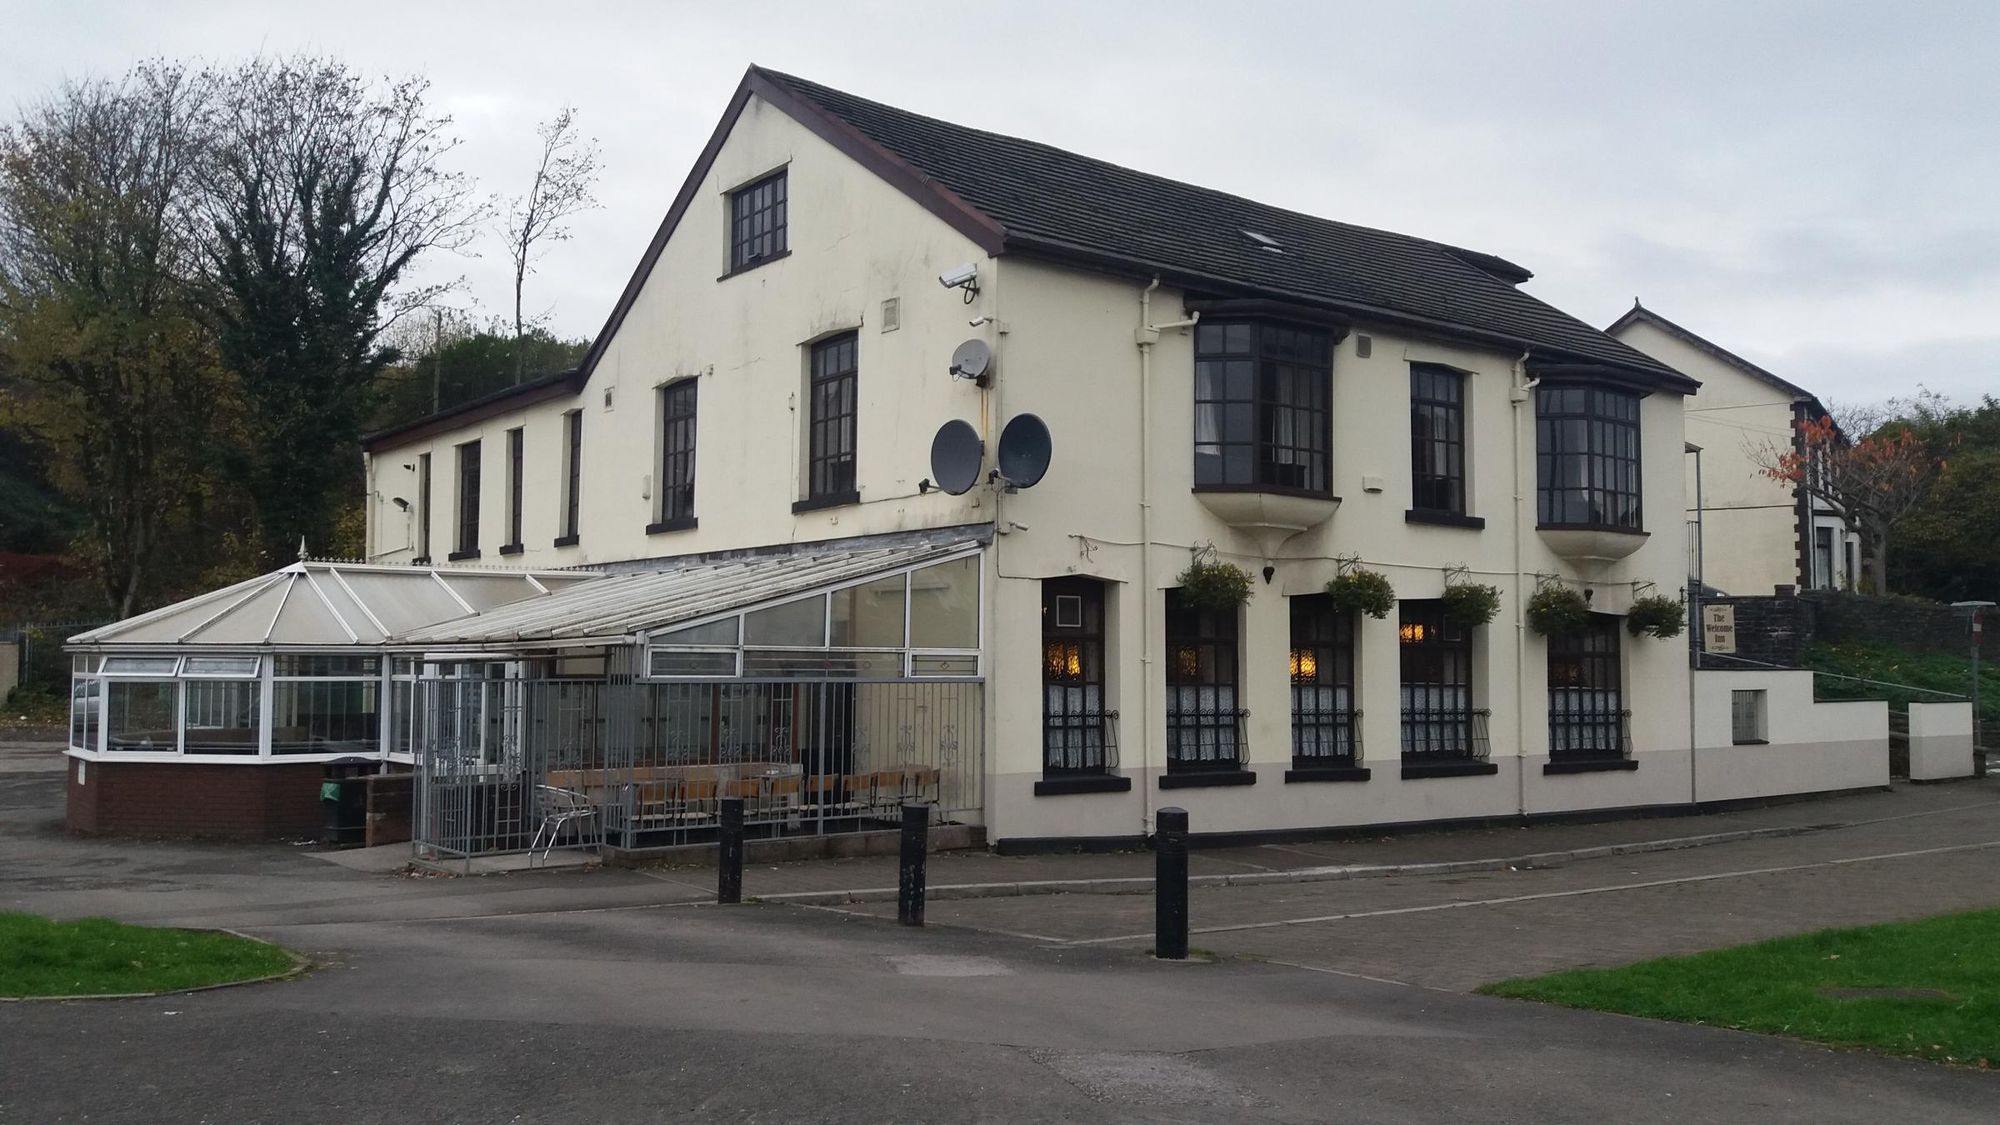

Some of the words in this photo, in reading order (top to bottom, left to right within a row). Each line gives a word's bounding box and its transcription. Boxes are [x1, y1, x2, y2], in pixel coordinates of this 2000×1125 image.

[1713, 613, 1725, 622] The
[1706, 624, 1733, 633] Welcome
[1715, 634, 1725, 643] Inn
